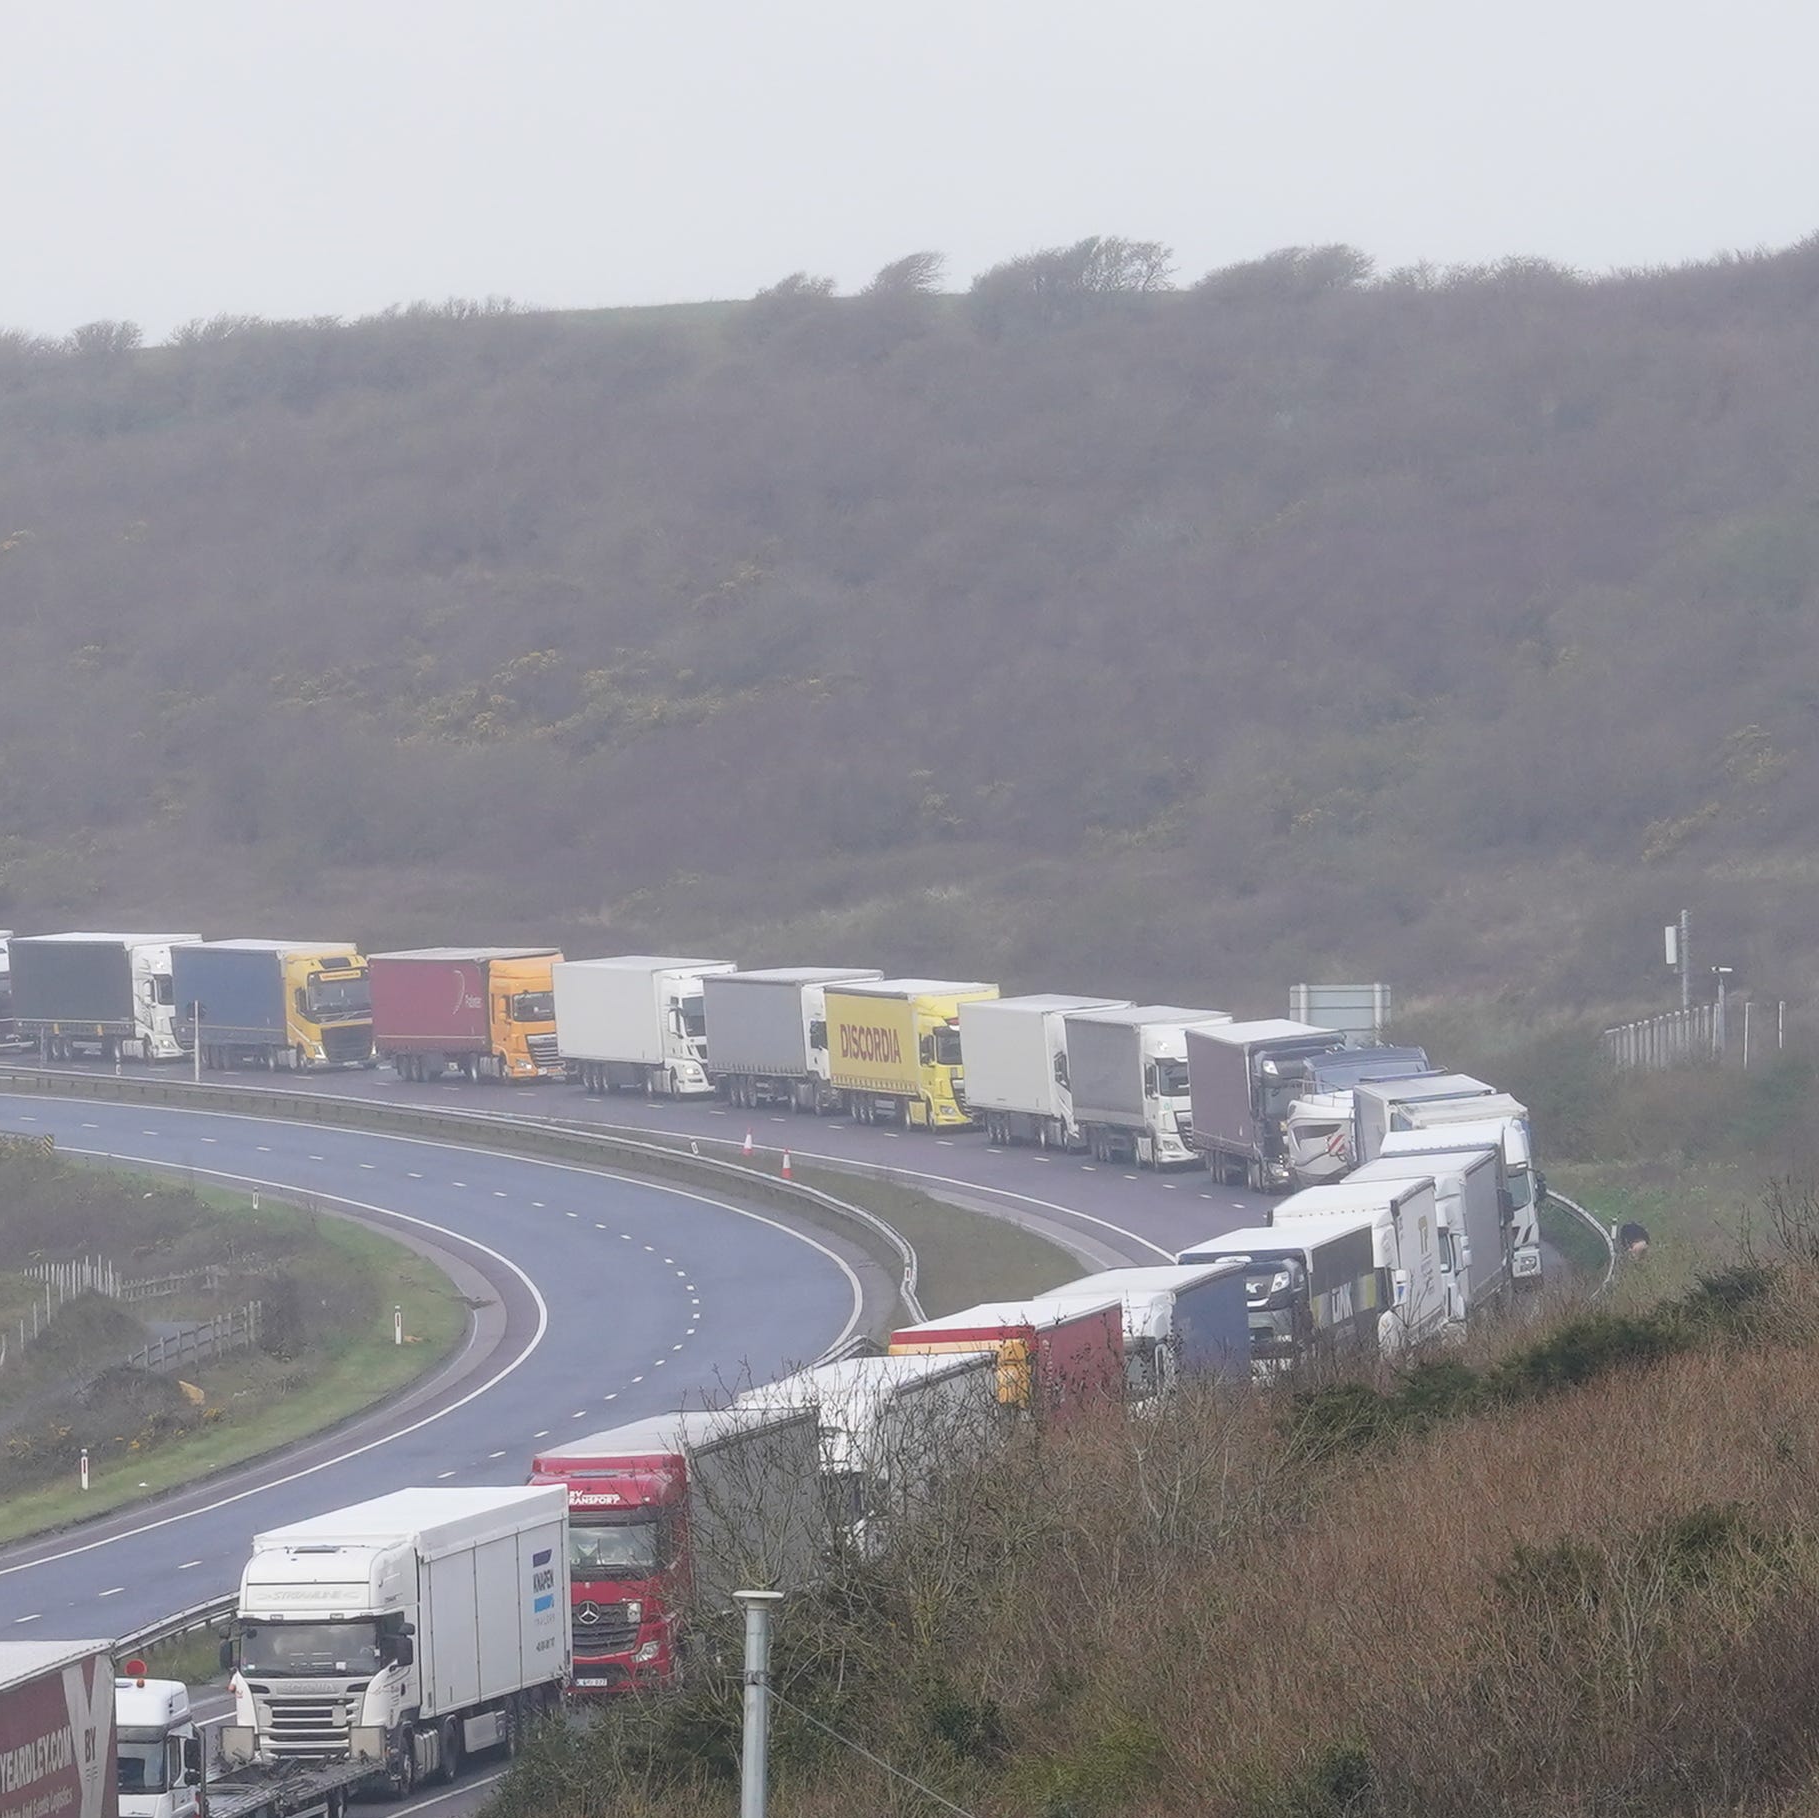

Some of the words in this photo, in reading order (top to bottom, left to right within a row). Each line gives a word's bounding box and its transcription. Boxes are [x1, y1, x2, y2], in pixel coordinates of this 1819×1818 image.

[840, 1023, 902, 1064] DISCORDIA
[569, 1494, 620, 1504] RANSPORT
[84, 1726, 97, 1764] BY
